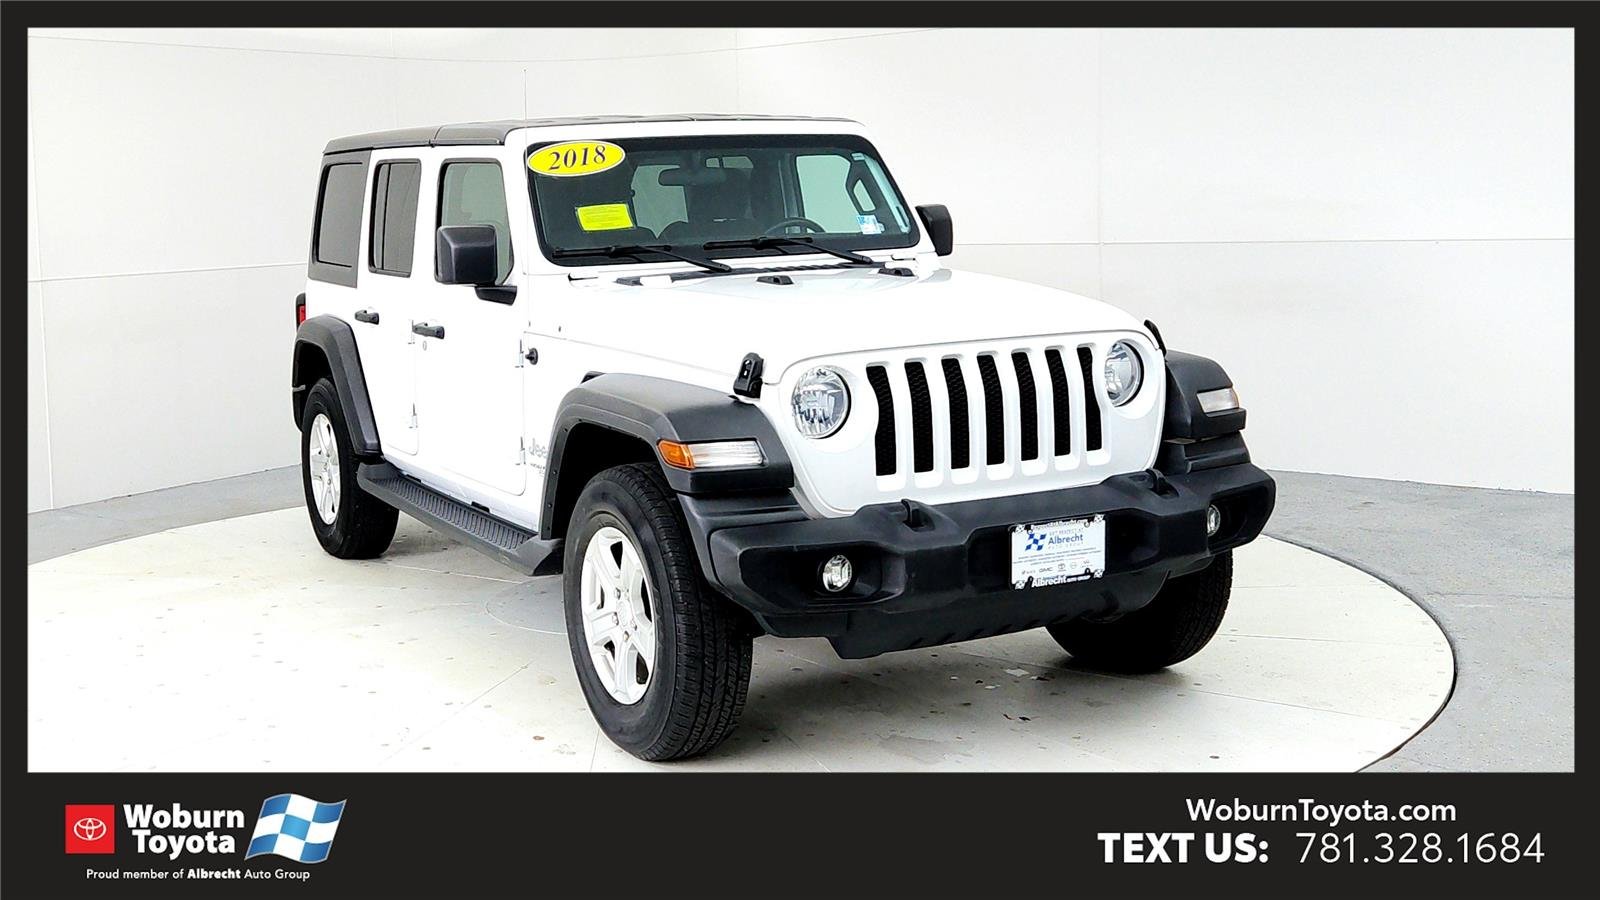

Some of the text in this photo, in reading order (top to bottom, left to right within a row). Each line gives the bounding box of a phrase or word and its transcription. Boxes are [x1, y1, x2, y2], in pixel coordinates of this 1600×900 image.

[549, 145, 606, 171] 2018
[529, 437, 548, 459] Jee
[1048, 533, 1084, 545] Albrecht
[1031, 575, 1066, 588] Albrecht
